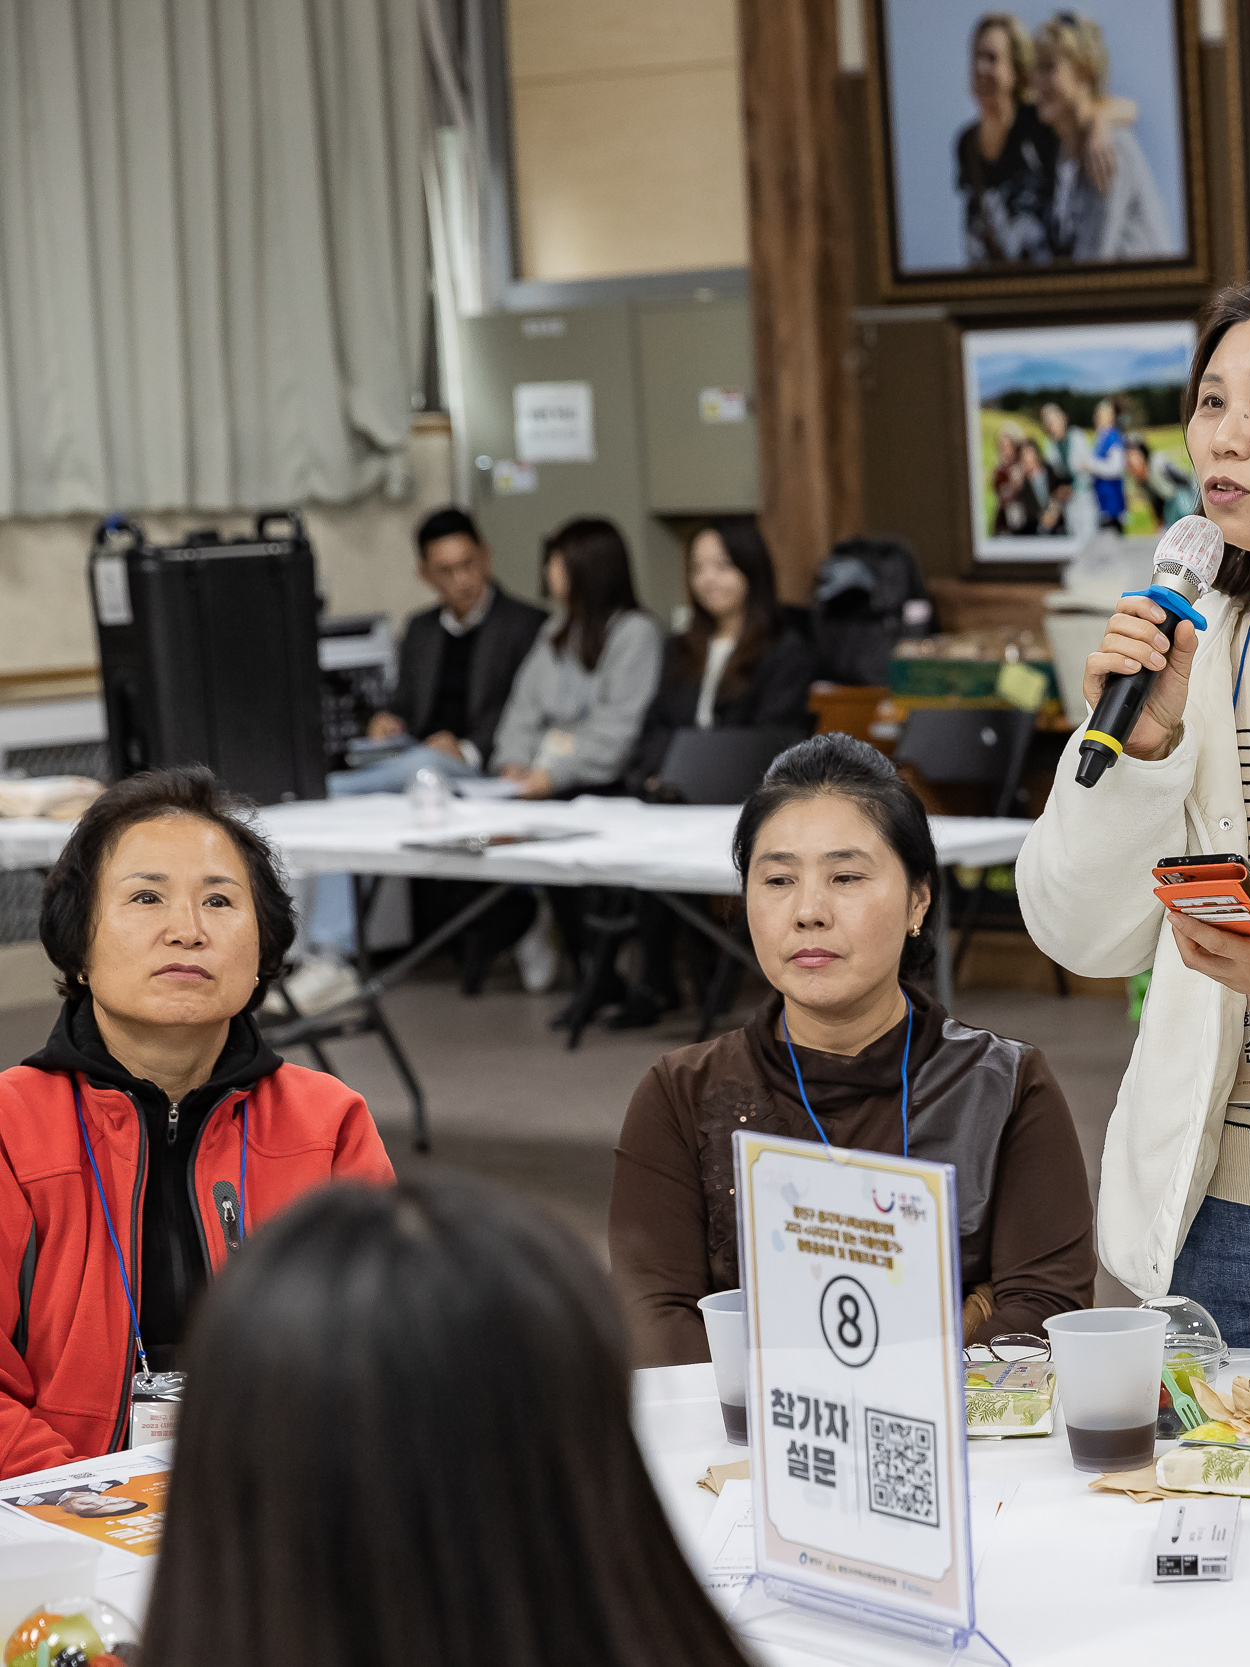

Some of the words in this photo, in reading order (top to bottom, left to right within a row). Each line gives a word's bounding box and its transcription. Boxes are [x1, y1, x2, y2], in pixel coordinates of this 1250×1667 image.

[838, 1294, 862, 1348] 8
[771, 1388, 849, 1443] 참가자
[787, 1440, 836, 1488] 설문
